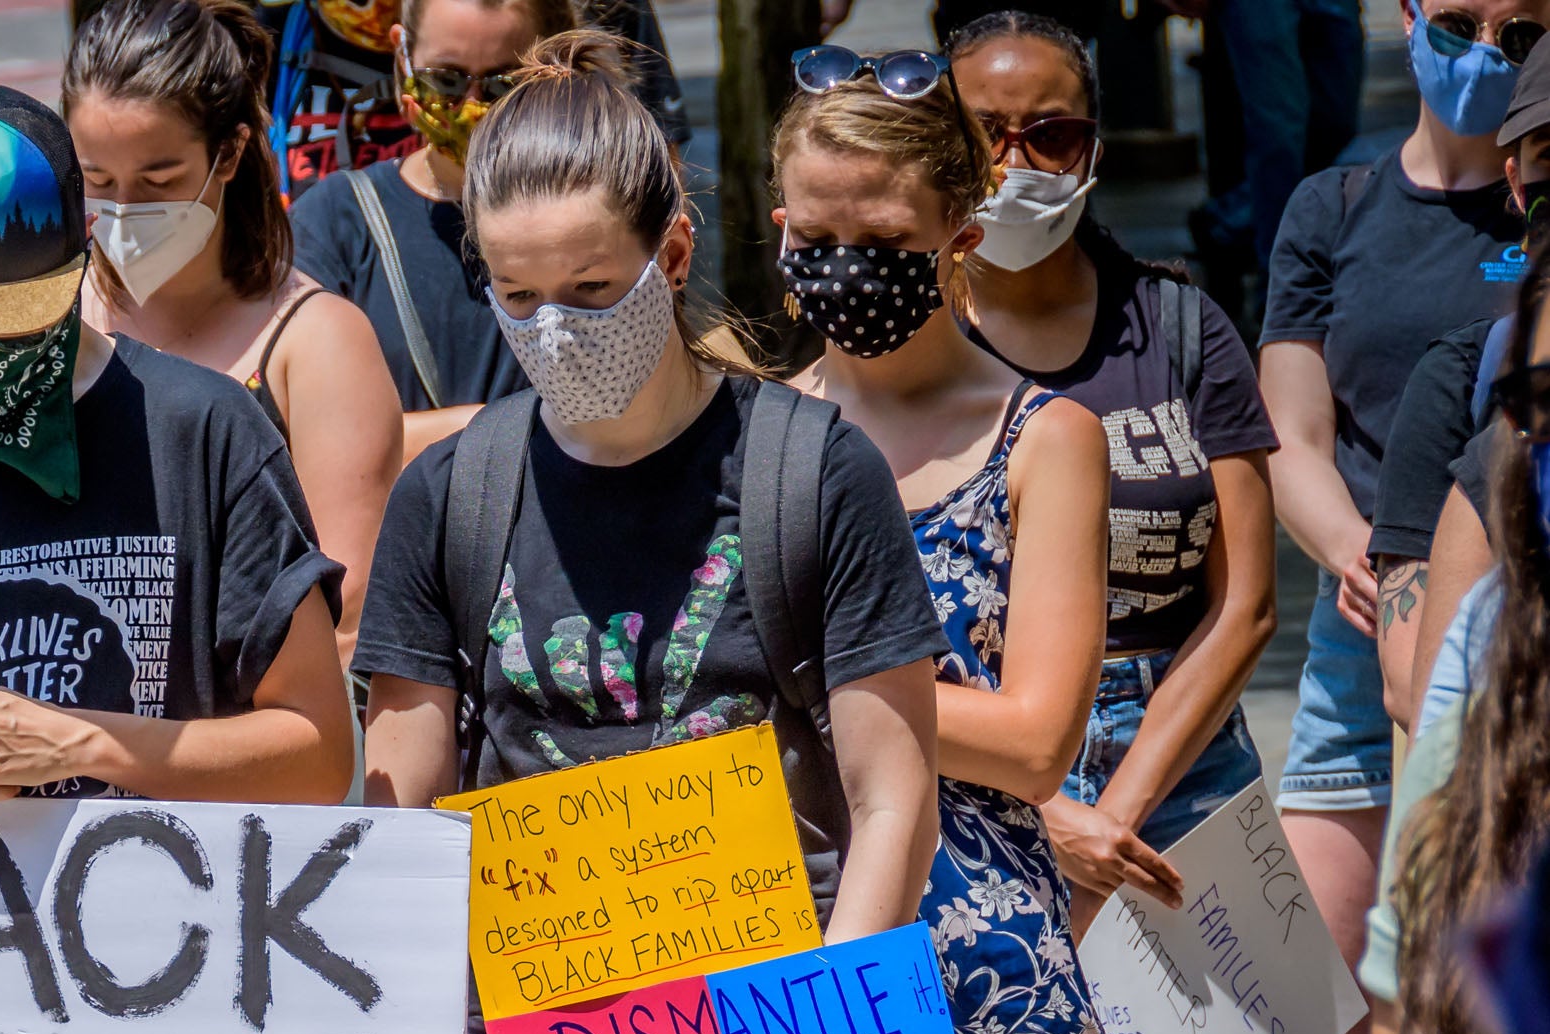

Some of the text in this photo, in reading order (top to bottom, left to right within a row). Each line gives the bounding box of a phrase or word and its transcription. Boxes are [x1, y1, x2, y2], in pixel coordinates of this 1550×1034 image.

[0, 536, 112, 566] RESTORATIVE
[114, 535, 177, 554] JUSTICE
[134, 580, 175, 597] BLACK
[143, 625, 172, 639] VALUE
[468, 753, 764, 842] The only way to
[578, 856, 600, 882] a
[609, 825, 717, 876] system
[1236, 795, 1307, 945] BLACK
[485, 860, 797, 952] designed to rip apart
[510, 907, 814, 1003] BLACK FAMILIES is
[908, 938, 947, 1017] it!
